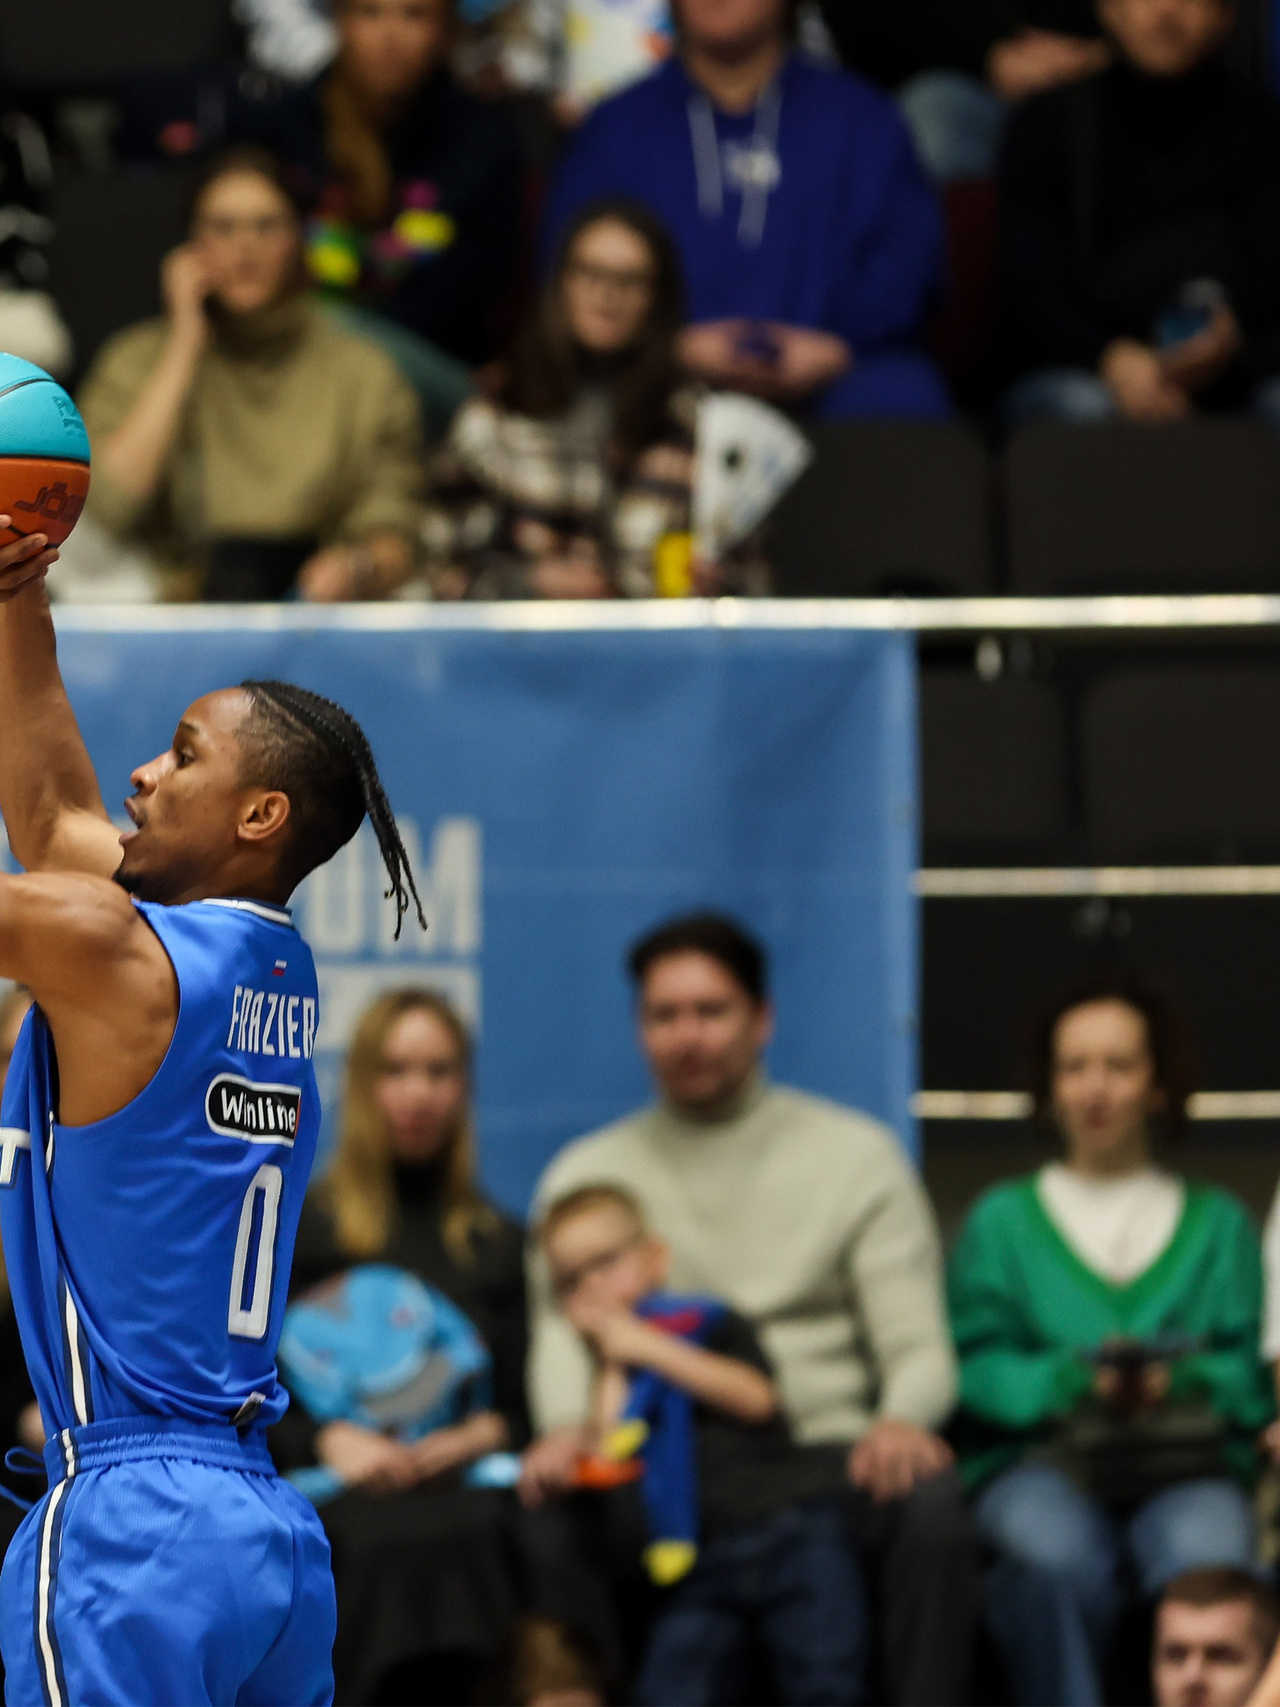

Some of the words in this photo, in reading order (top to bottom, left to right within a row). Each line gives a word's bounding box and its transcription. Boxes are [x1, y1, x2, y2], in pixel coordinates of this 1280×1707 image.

[226, 984, 316, 1060] FRAZIER
[221, 1087, 297, 1133] Winline
[228, 1164, 283, 1339] 0
